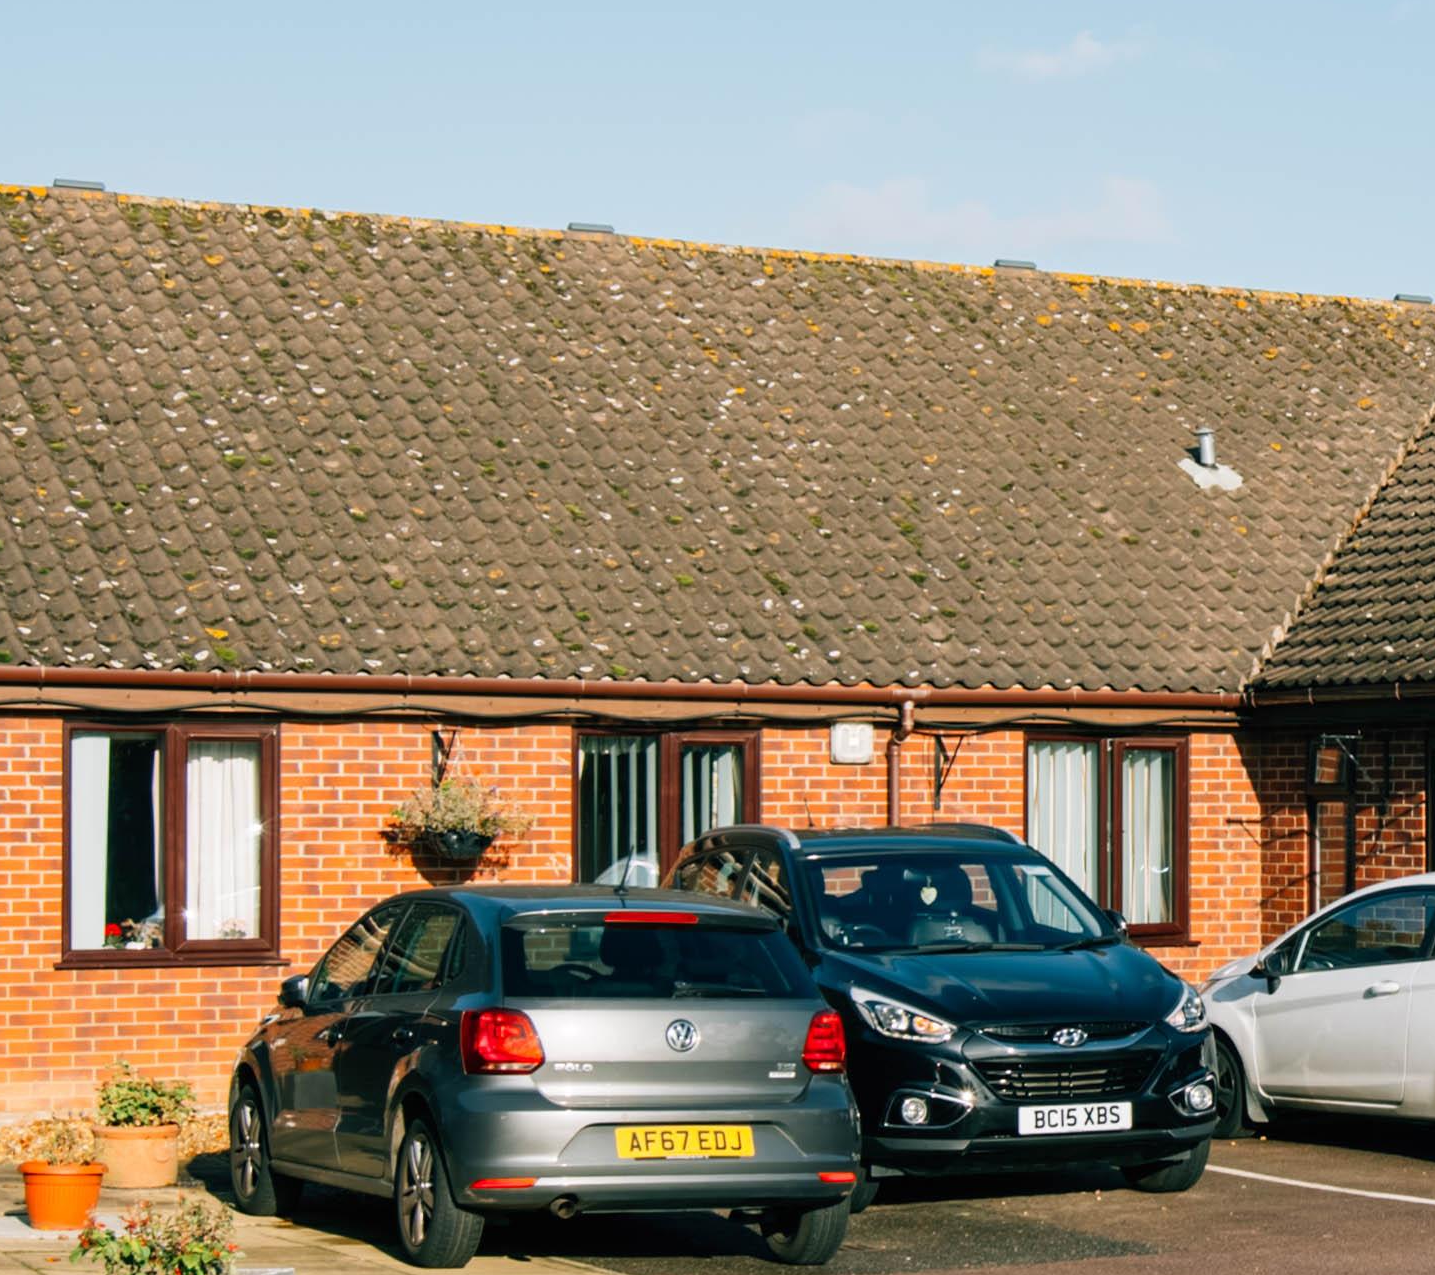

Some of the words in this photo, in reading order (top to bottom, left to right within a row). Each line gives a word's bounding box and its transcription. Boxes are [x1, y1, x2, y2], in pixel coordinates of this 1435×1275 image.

[1034, 1108, 1077, 1129] BC15
[1084, 1105, 1120, 1126] XBS
[629, 1129, 690, 1152] AF67
[698, 1130, 742, 1151] EDJ
